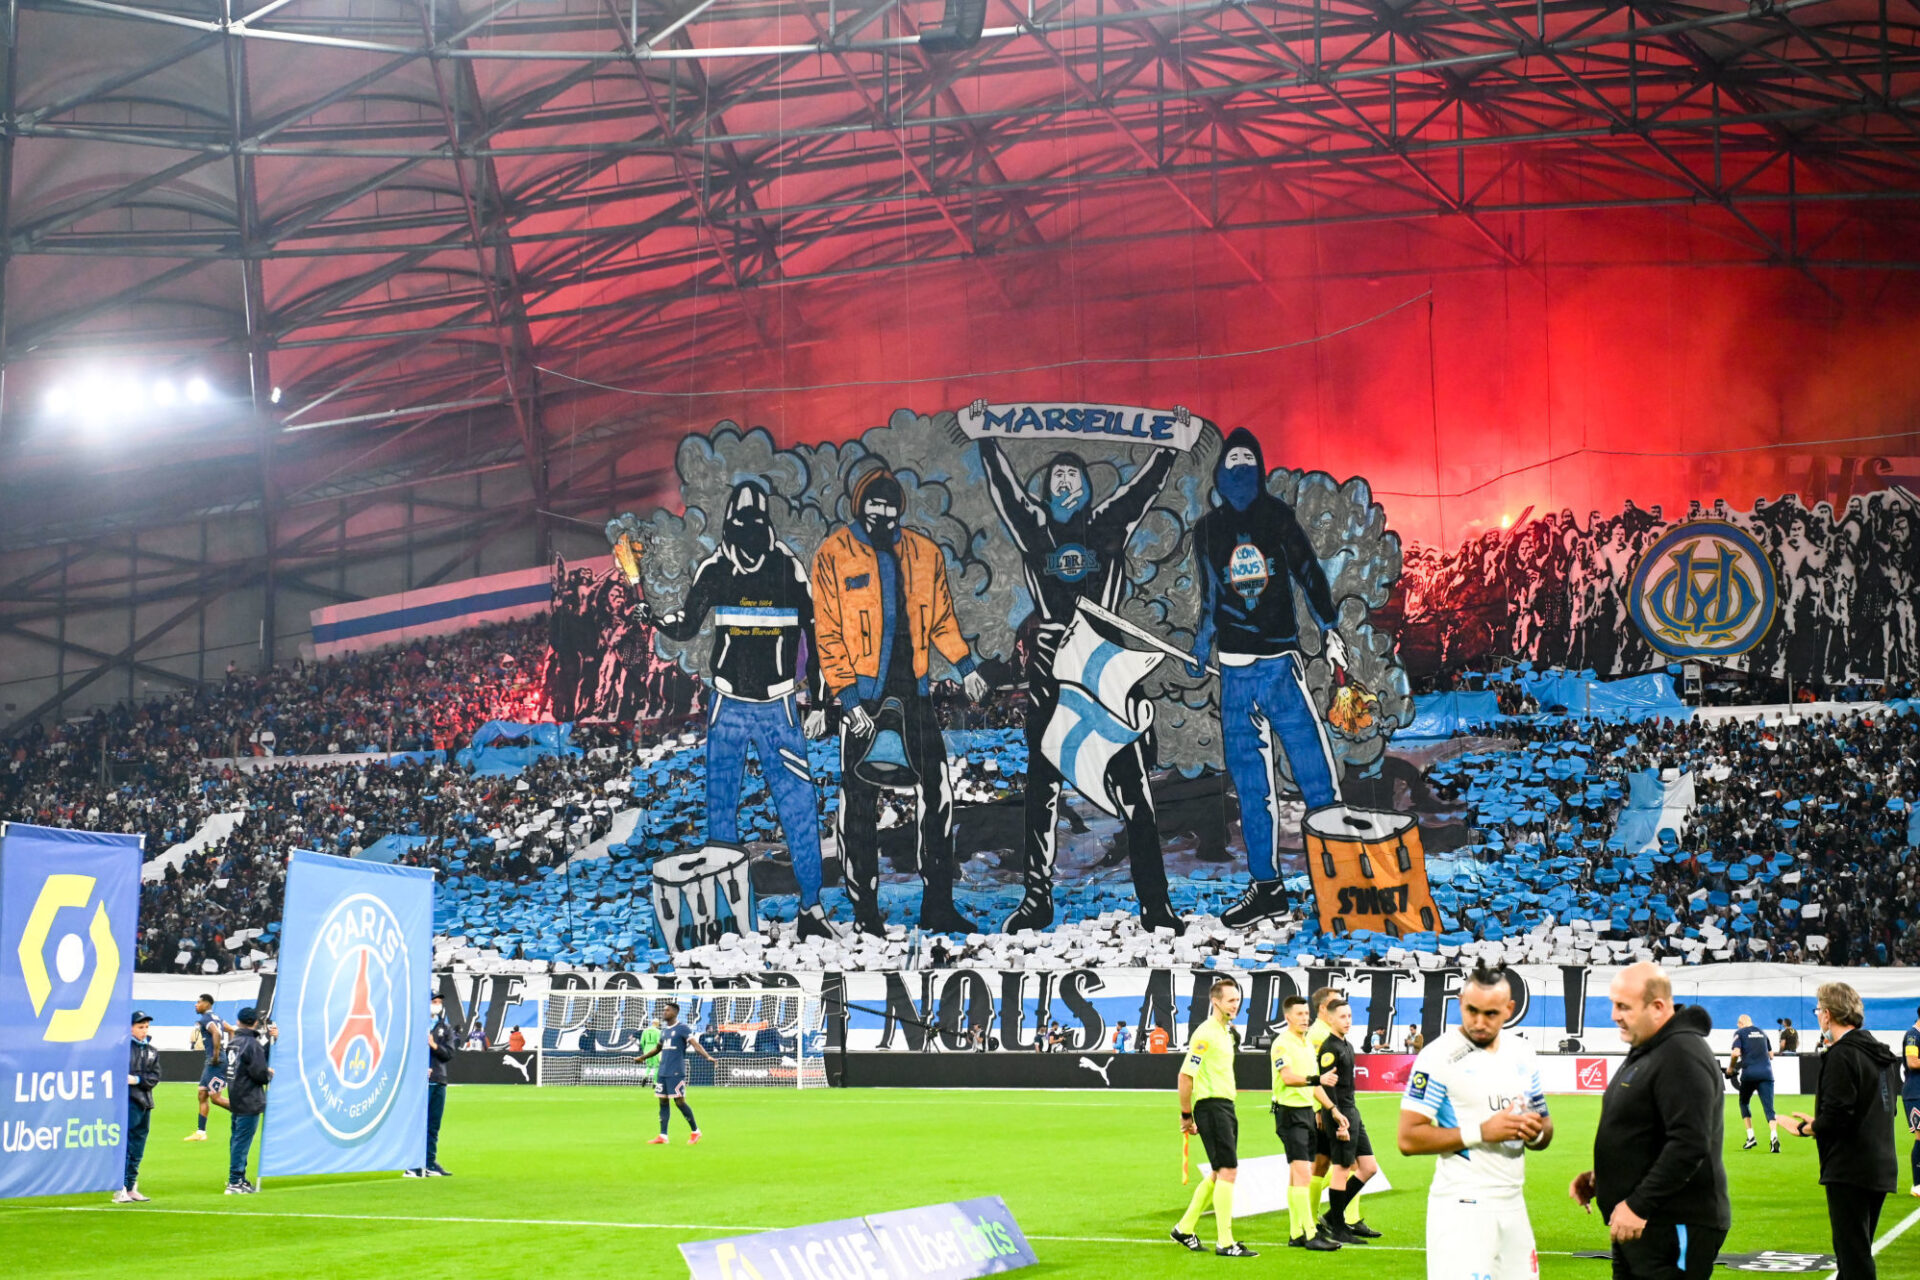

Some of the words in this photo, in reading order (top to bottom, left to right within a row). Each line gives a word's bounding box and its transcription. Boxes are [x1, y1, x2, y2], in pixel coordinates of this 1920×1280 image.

[982, 408, 1177, 440] MARSEILLE
[325, 905, 400, 964] PARIS
[875, 969, 1105, 1051] NOUS
[14, 1070, 95, 1103] LIGUE
[100, 1070, 113, 1099] 1
[2, 1120, 62, 1152] Uber
[65, 1117, 121, 1149] Eats
[903, 1224, 966, 1275] Uber
[951, 1214, 1019, 1263] Eats
